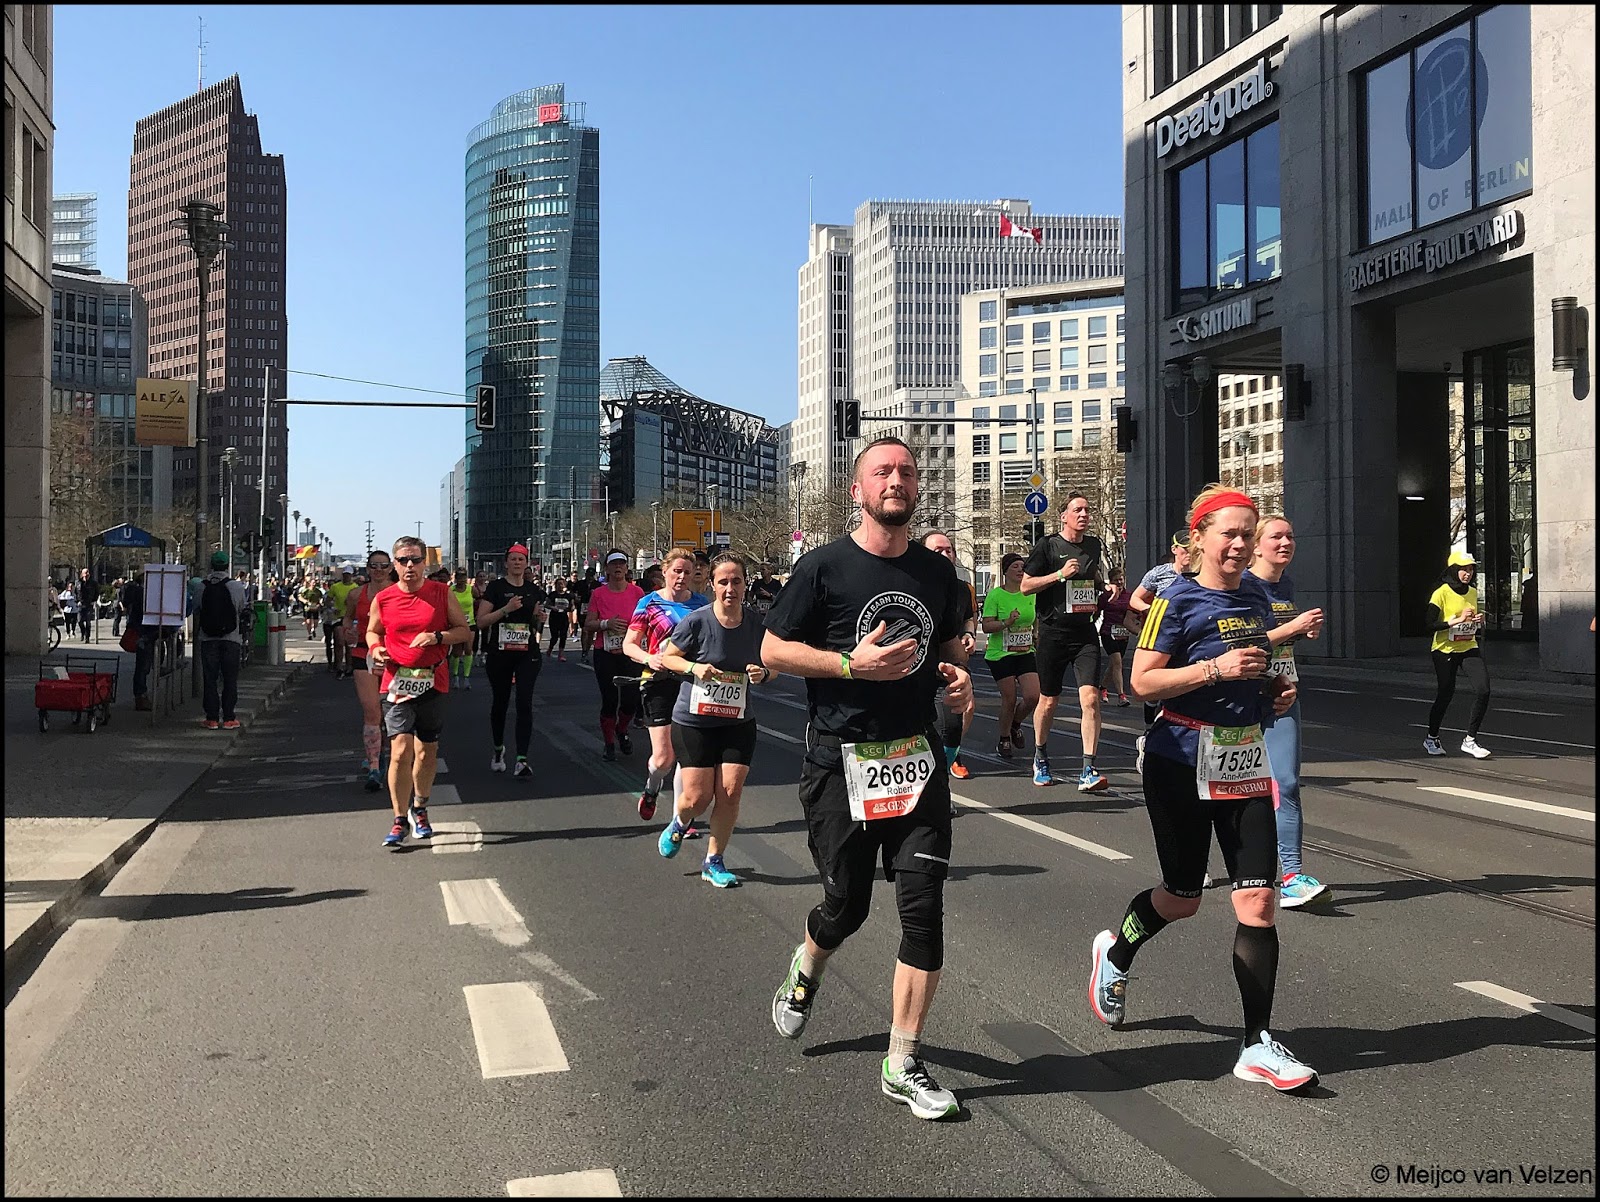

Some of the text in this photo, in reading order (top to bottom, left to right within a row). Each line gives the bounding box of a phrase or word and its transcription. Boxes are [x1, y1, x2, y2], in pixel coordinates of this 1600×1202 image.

[1374, 157, 1530, 231] MALL OF BERLIN
[1348, 209, 1518, 292] BAGETERIE BOULEVARD
[1200, 297, 1253, 339] SATURN
[123, 528, 132, 539] U
[860, 595, 931, 636] TEAM EARN YOUR BACON
[398, 679, 431, 693] 26688
[704, 684, 741, 700] 37105
[863, 740, 922, 756] SCC EVENTS
[1217, 746, 1263, 772] 15292
[866, 758, 930, 789] 26689
[887, 785, 913, 796] Robert
[1228, 782, 1268, 795] GENERALI
[1250, 879, 1268, 887] cep
